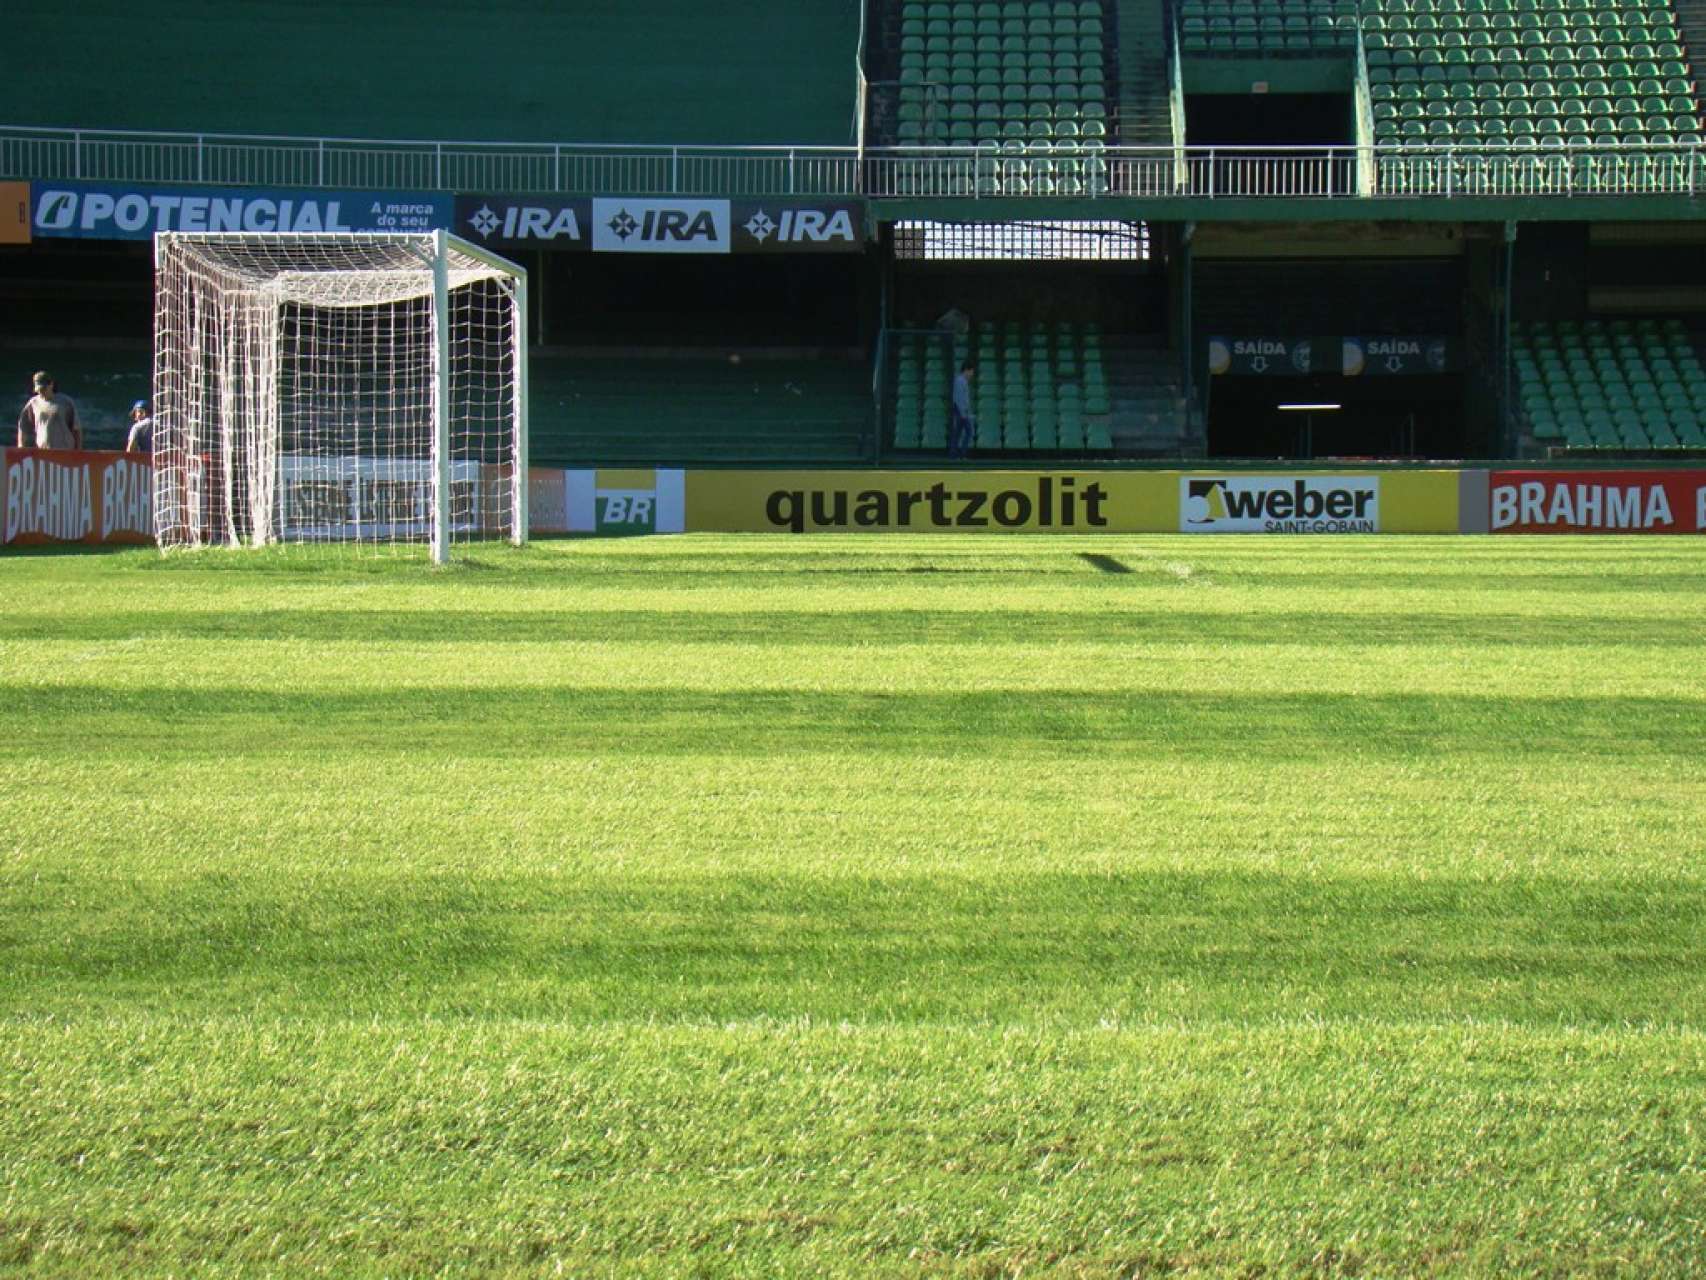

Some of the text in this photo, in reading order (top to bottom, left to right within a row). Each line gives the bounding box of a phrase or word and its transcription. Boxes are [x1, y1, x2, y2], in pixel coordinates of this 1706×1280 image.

[81, 192, 351, 232] POTENCIAL
[371, 202, 434, 214] A marca
[377, 215, 429, 226] do seu
[502, 207, 581, 241] IRA
[640, 209, 718, 242] IRA
[777, 209, 854, 242] IRA
[1234, 338, 1287, 355] SAÍDA
[1368, 338, 1421, 355] SAÍDA
[6, 456, 93, 544] BRAHMA
[603, 497, 651, 524] BR
[766, 477, 1108, 534] quartzolit
[1224, 479, 1375, 519] weber
[1492, 481, 1675, 530] BRAHMA
[1265, 519, 1375, 534] SAINT-GOBAIN
